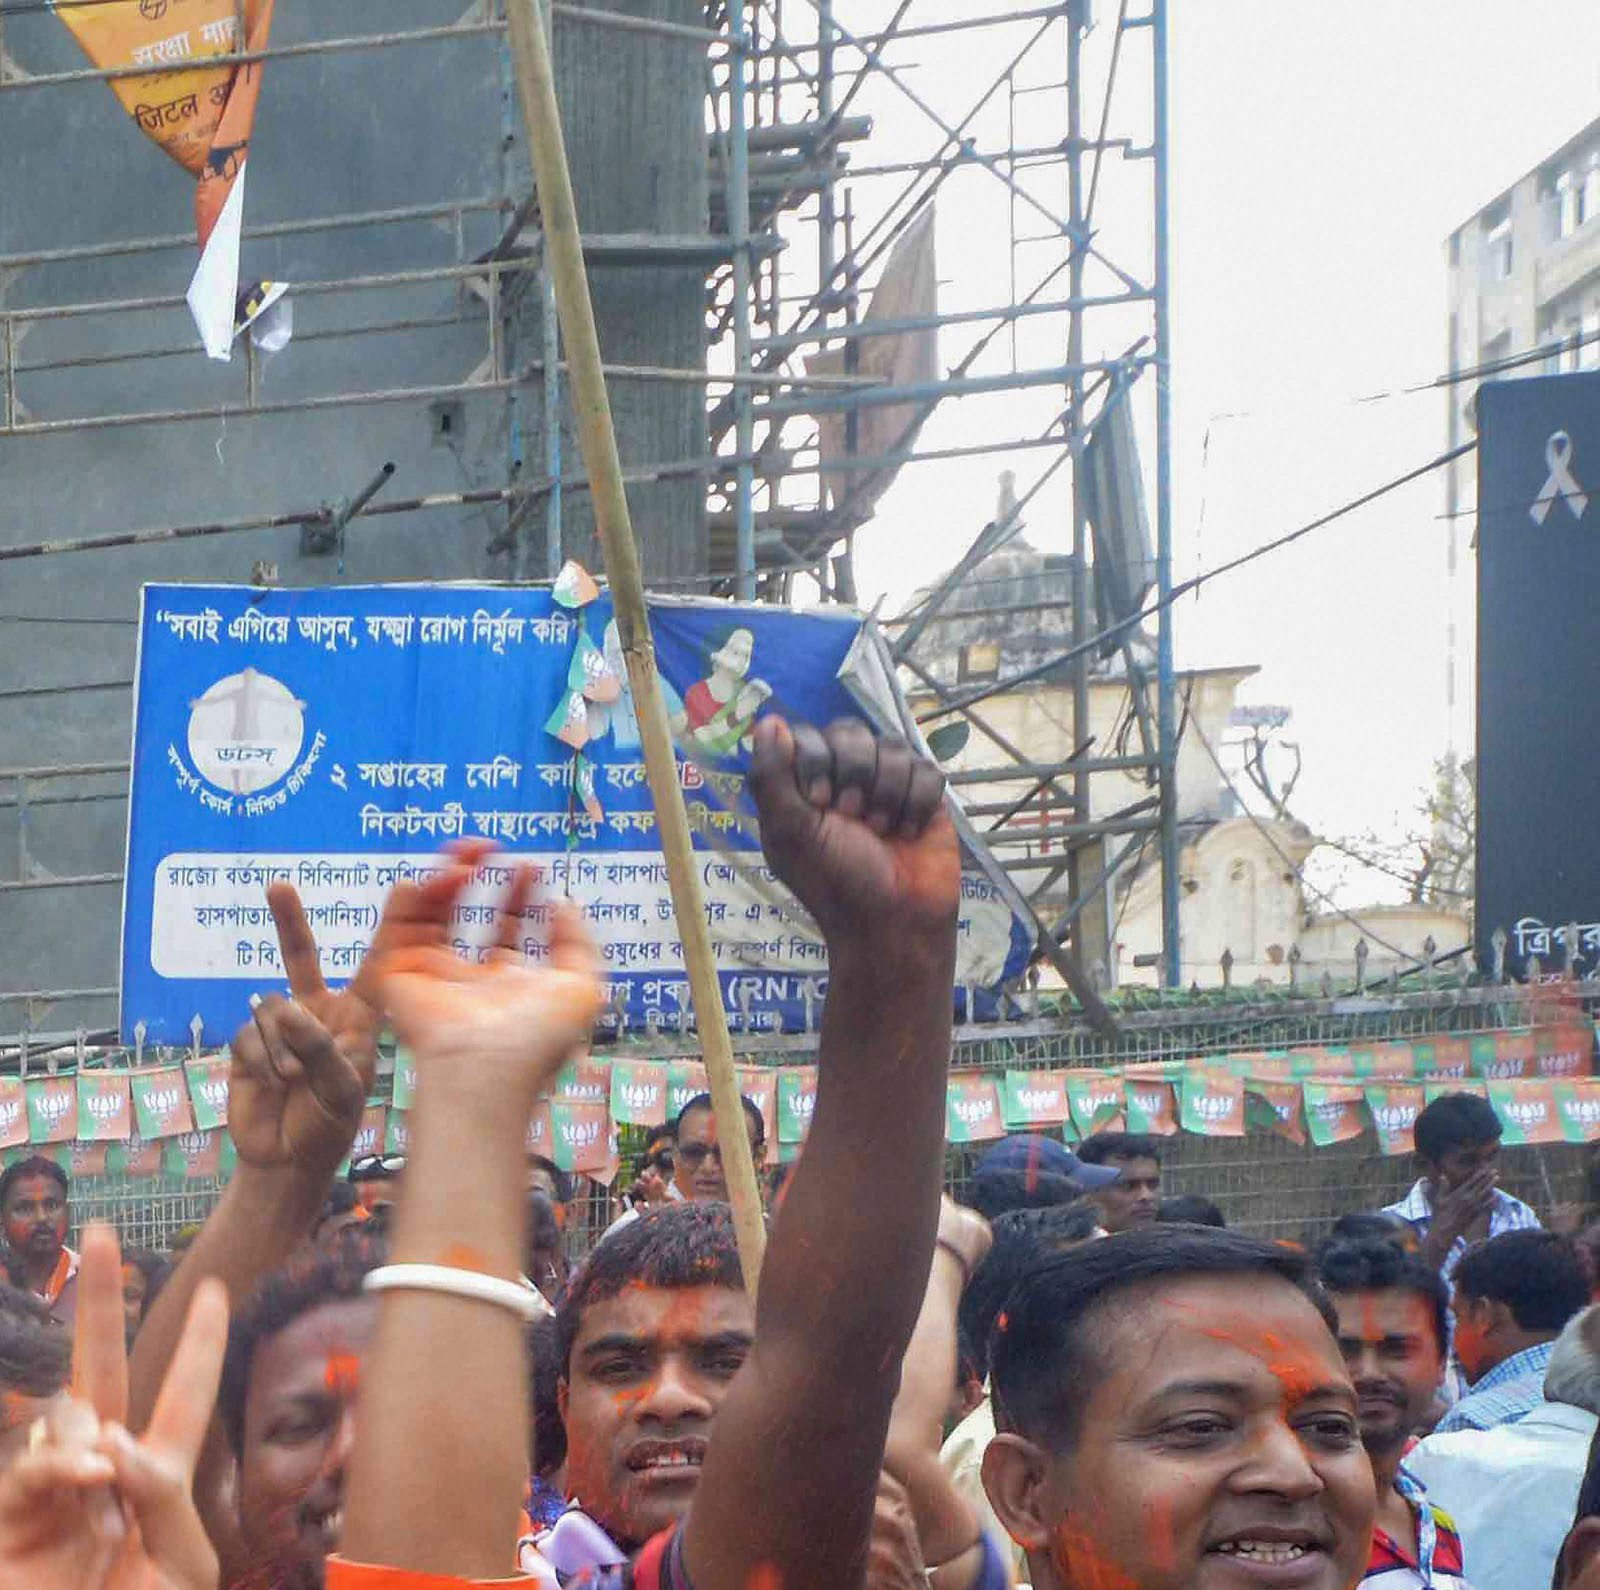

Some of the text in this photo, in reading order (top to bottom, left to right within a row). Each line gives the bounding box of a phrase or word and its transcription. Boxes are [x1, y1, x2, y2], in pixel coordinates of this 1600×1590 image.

[228, 608, 291, 643] এগিয়ে
[297, 614, 358, 651] আসুন,
[420, 613, 468, 643] রোগ
[357, 761, 448, 792] সপ্তাহের
[465, 755, 522, 788] বেশি
[359, 802, 468, 837] নিকটবর্তী
